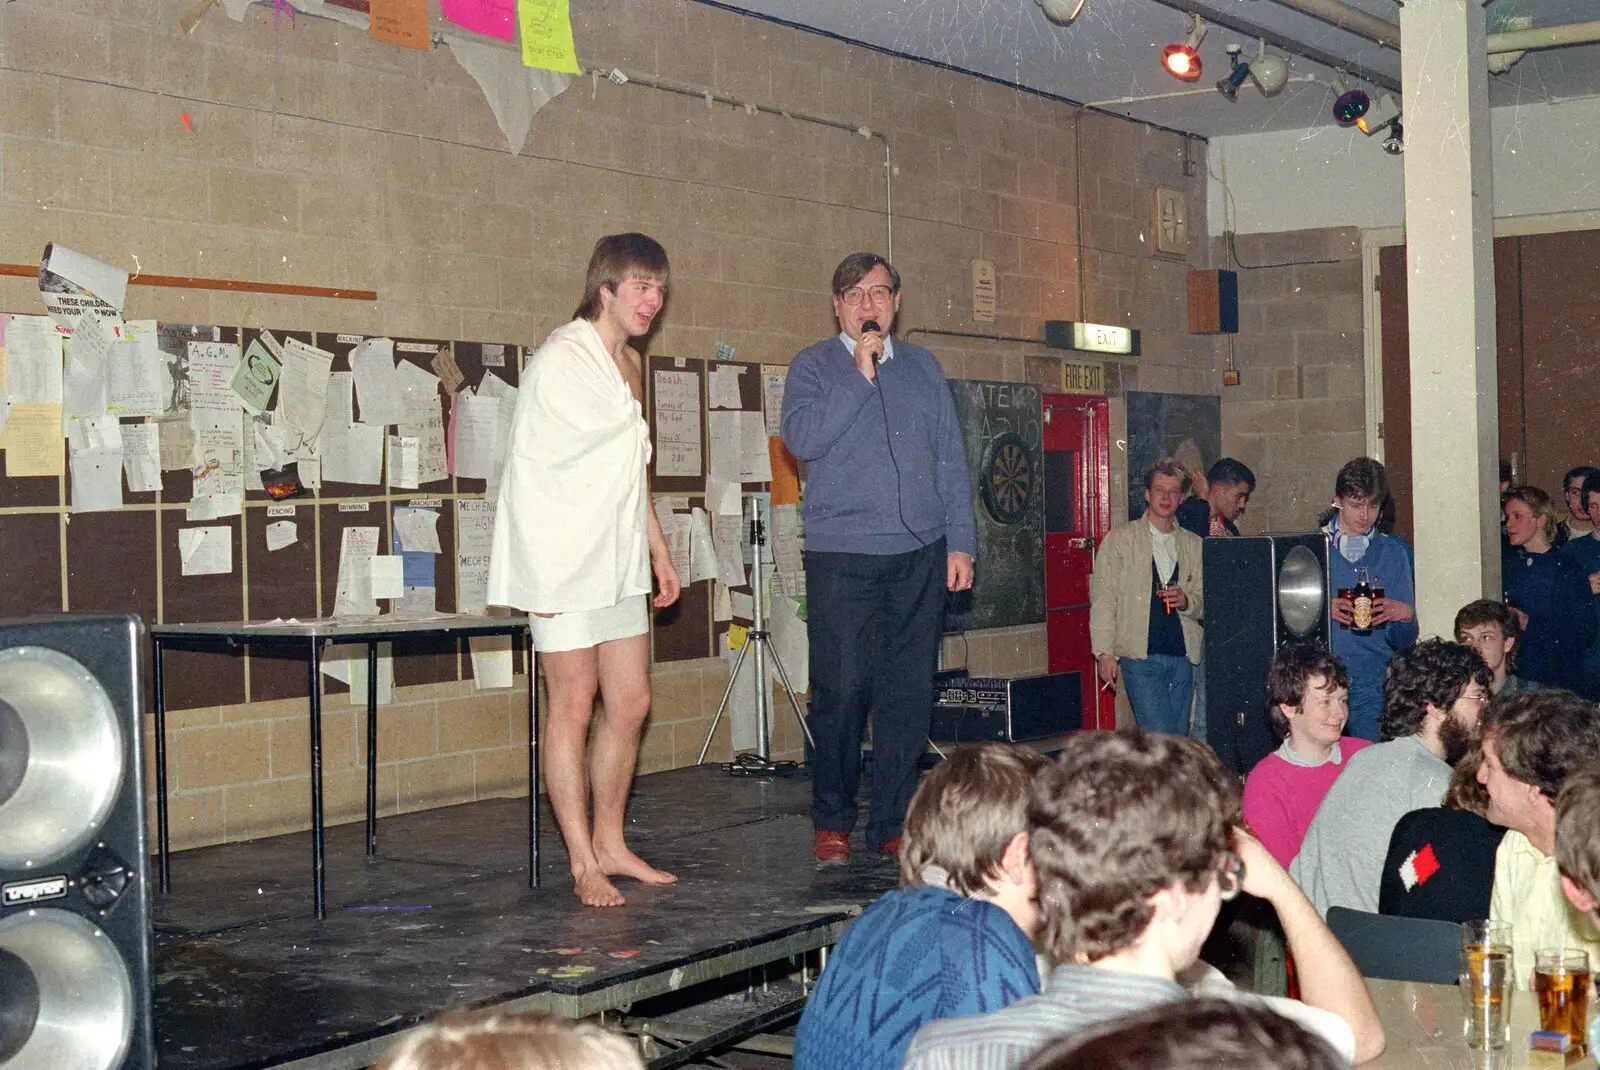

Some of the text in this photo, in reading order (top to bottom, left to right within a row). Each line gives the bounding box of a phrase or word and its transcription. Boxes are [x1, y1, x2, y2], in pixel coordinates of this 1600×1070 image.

[57, 297, 113, 308] THESE CHILDRE
[46, 305, 62, 315] NEED
[63, 306, 82, 316] YOUR
[100, 309, 117, 317] NOW
[337, 335, 363, 343] WALKING
[1097, 329, 1117, 346] EXIT
[192, 344, 229, 358] A.G.M.
[1065, 363, 1101, 391] FIRE EXIT
[268, 507, 294, 516] FENCING
[340, 503, 368, 511] SWIMMING
[460, 501, 481, 512] MECH
[460, 556, 481, 567] MECH
